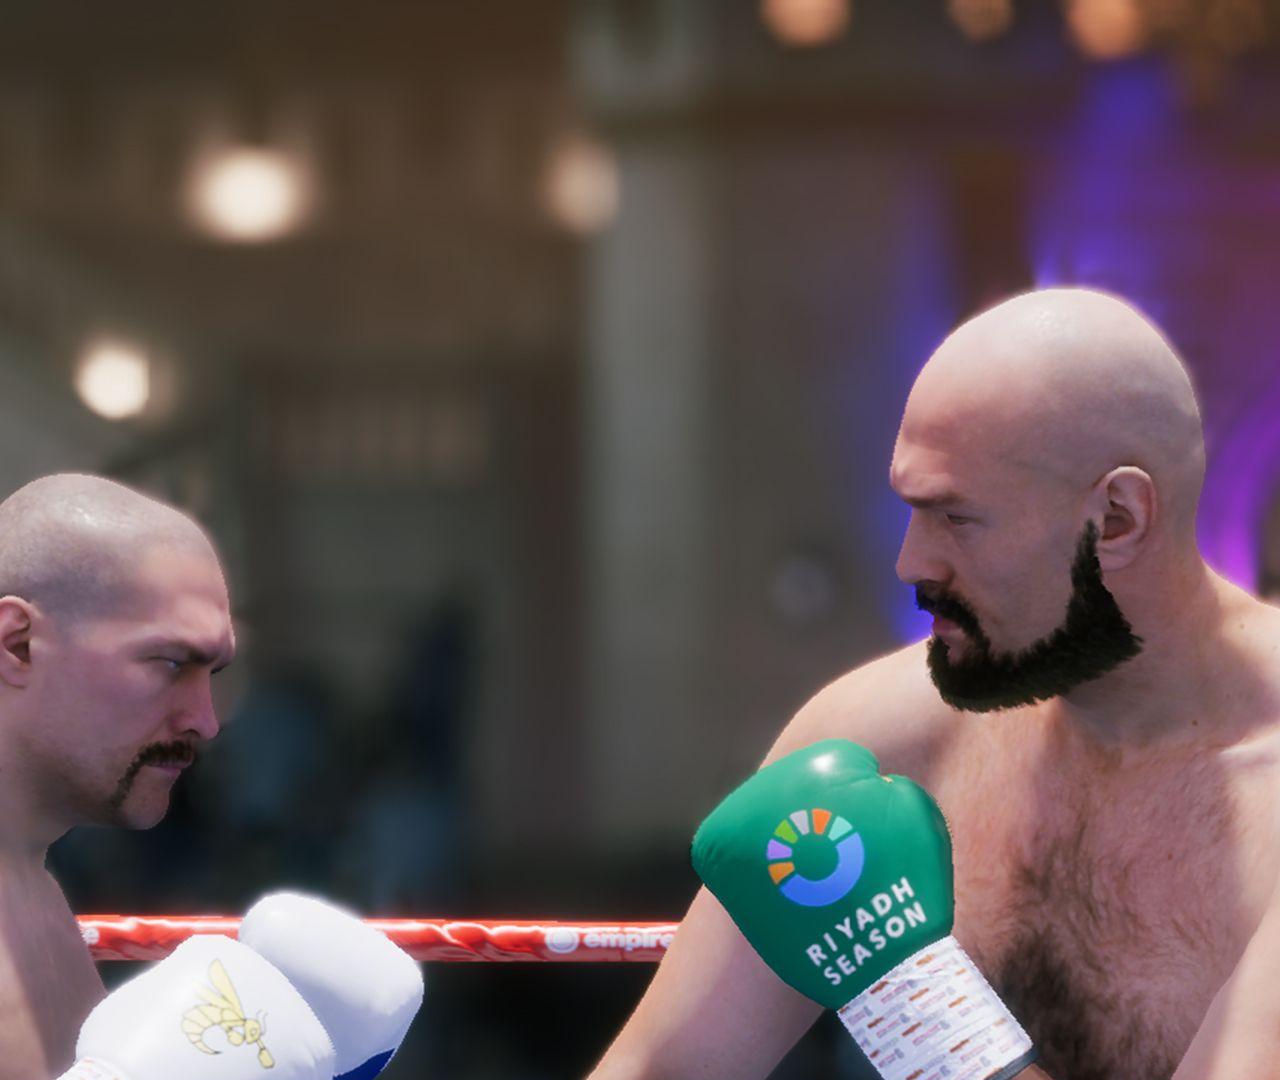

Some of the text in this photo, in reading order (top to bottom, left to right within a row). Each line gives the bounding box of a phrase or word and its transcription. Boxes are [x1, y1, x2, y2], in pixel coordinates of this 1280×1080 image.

[584, 929, 675, 951] empire
[806, 876, 914, 967] RIYADH
[824, 901, 927, 986] SEASON
